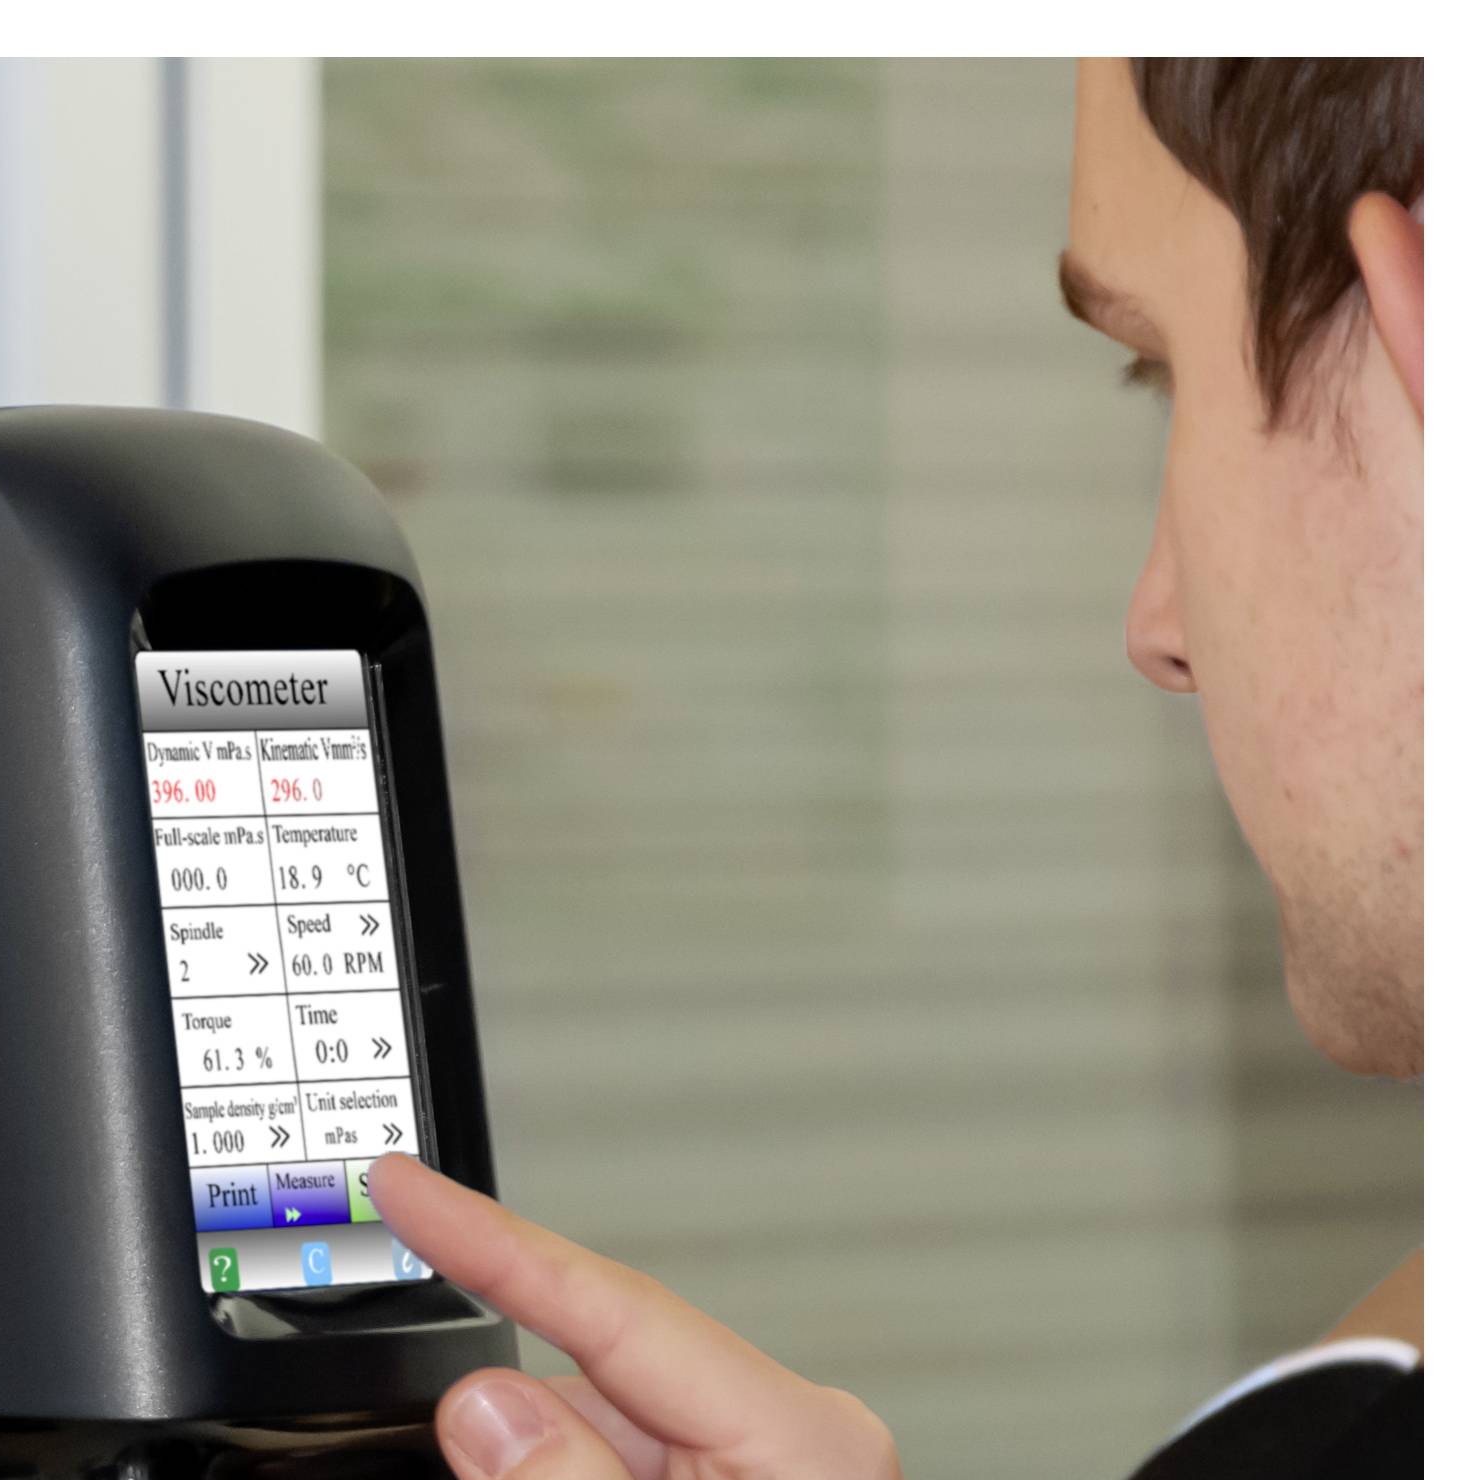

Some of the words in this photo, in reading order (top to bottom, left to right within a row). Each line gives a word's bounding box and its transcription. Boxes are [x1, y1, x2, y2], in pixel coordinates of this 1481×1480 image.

[158, 669, 328, 707] Viscometer
[147, 741, 200, 767] Dynamic
[202, 740, 213, 760] V
[217, 740, 252, 761] mPa.s
[260, 737, 319, 761] Kinematic
[154, 827, 220, 847] Full-scale
[224, 827, 264, 845] mPa.s
[272, 824, 358, 848] Temperature
[347, 863, 370, 888] °C
[170, 922, 224, 944] Spindle
[287, 913, 331, 938] Speed
[180, 960, 190, 982] 2
[344, 951, 384, 974] RPM
[181, 1013, 232, 1035] Torque
[295, 1004, 338, 1025] Time
[256, 1046, 272, 1069] %
[315, 1038, 348, 1064] 0:0
[185, 1101, 225, 1123] Sample
[227, 1099, 265, 1120] density
[305, 1092, 336, 1112] Unit
[339, 1089, 398, 1111] selection
[325, 1126, 358, 1145] mPas
[277, 1171, 335, 1190] Measure
[207, 1182, 258, 1208] Print
